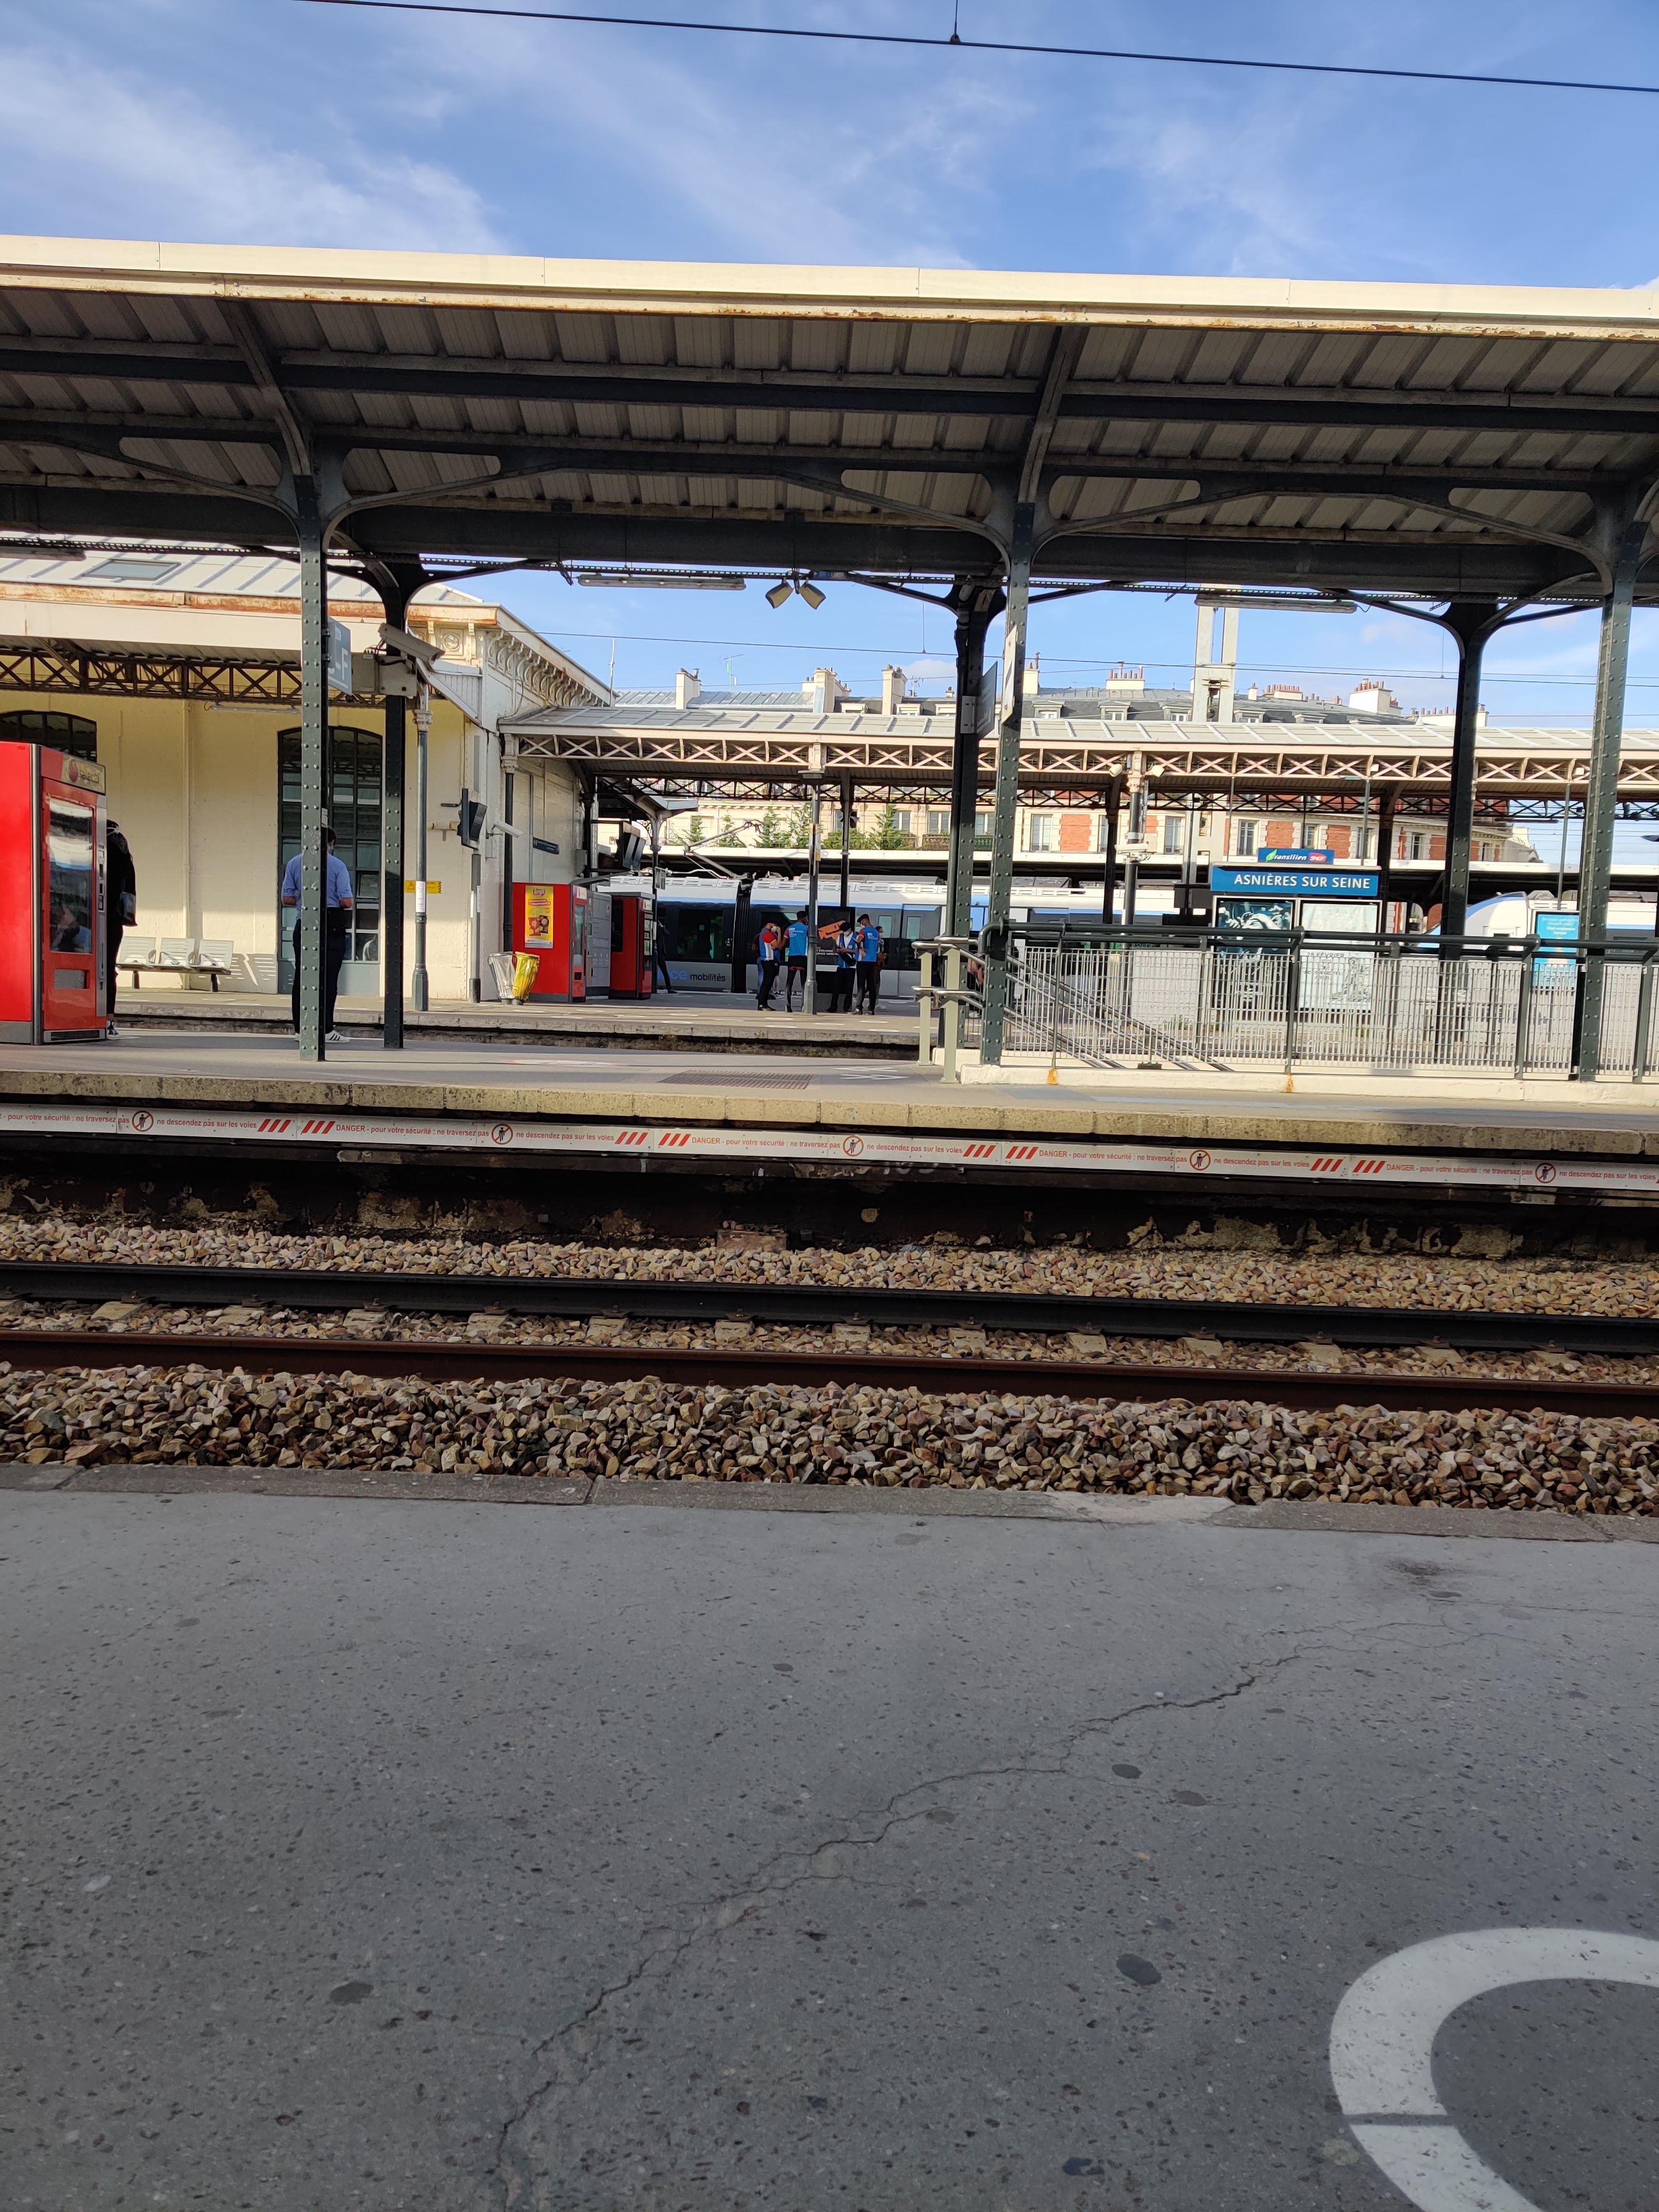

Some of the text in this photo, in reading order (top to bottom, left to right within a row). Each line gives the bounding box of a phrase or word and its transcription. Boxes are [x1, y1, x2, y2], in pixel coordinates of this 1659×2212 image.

[1234, 873, 1370, 889] ASNIÈRES SUR SEINE
[690, 973, 726, 982] mobilités
